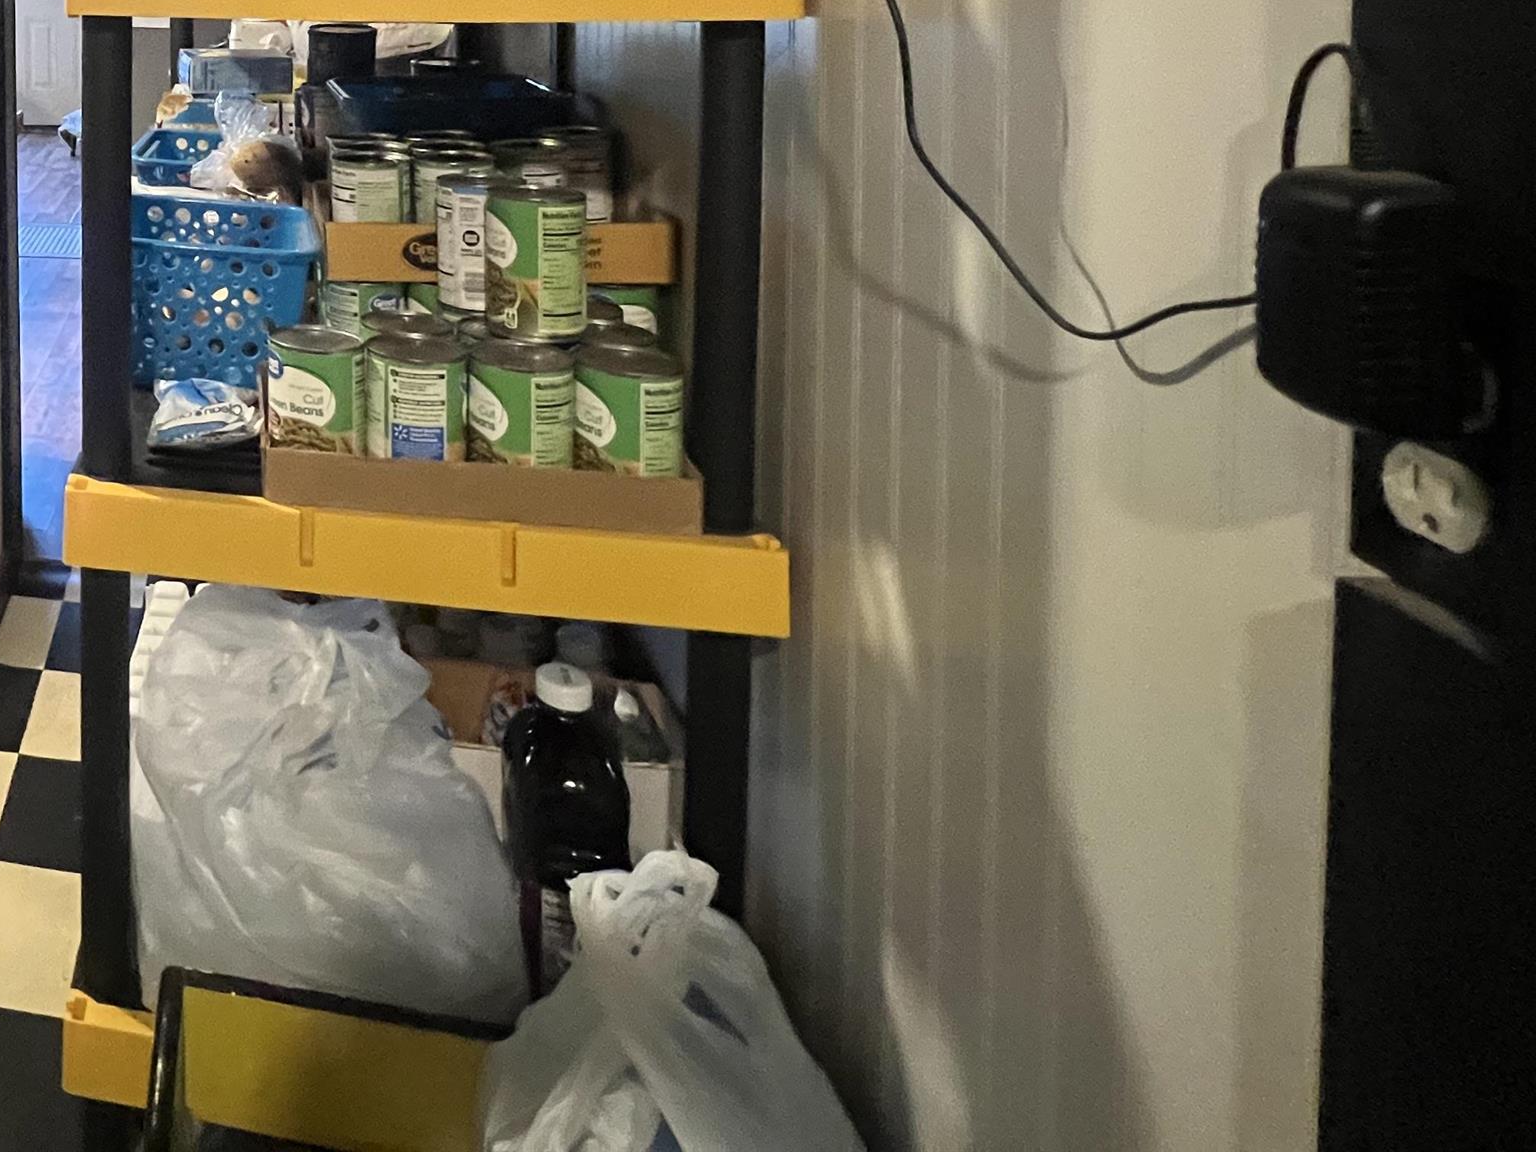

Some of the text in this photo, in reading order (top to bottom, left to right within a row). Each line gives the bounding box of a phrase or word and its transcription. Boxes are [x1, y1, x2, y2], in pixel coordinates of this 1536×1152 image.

[409, 242, 437, 255] Gre
[303, 394, 324, 405] Cut
[289, 402, 324, 417] Beans
